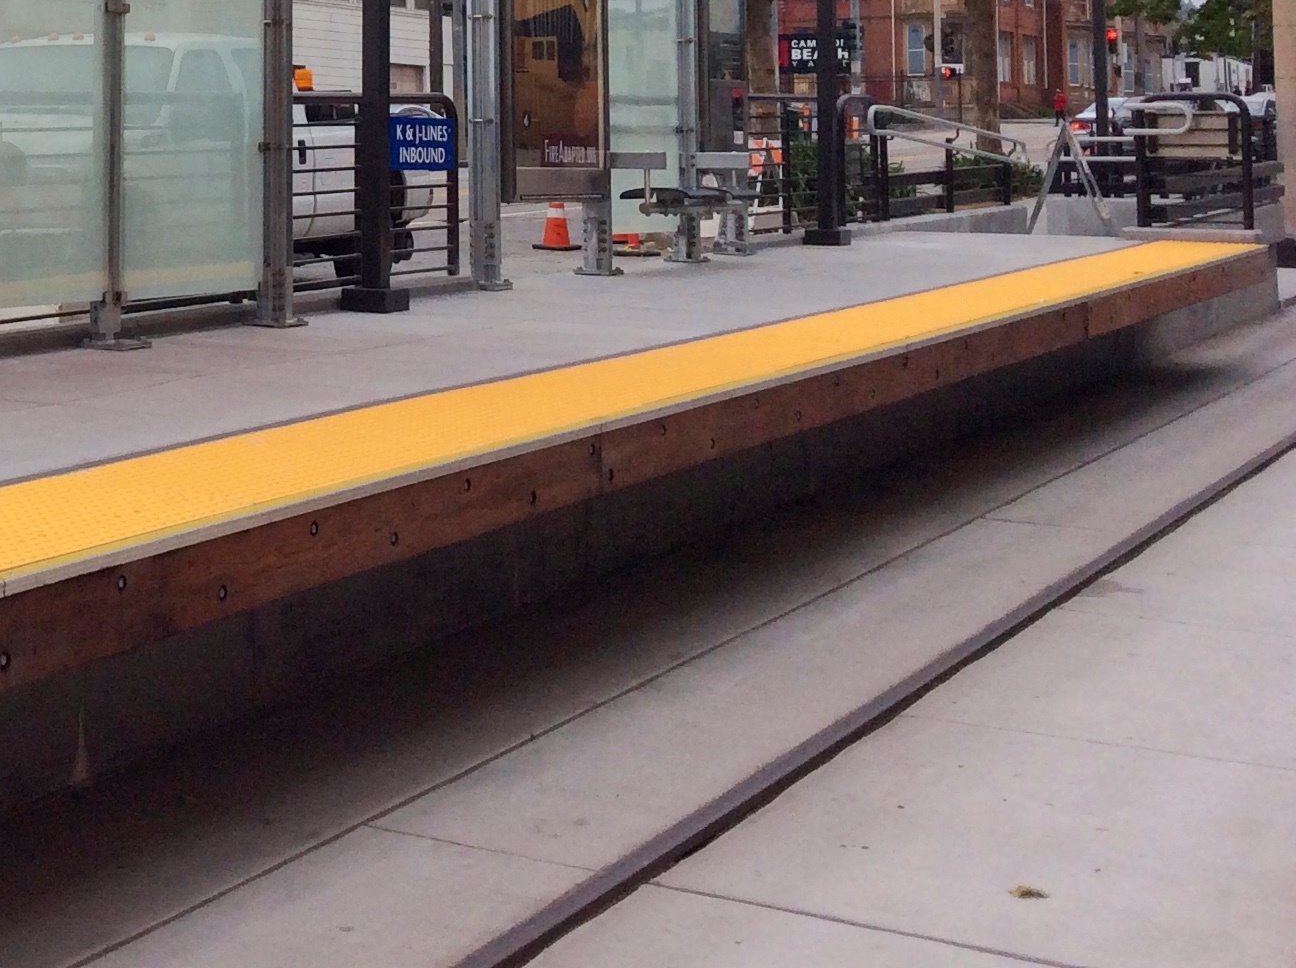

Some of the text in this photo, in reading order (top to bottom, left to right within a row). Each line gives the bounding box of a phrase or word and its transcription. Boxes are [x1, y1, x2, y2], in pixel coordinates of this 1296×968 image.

[396, 123, 448, 144] K & J-LINES
[399, 146, 446, 163] INBOUND
